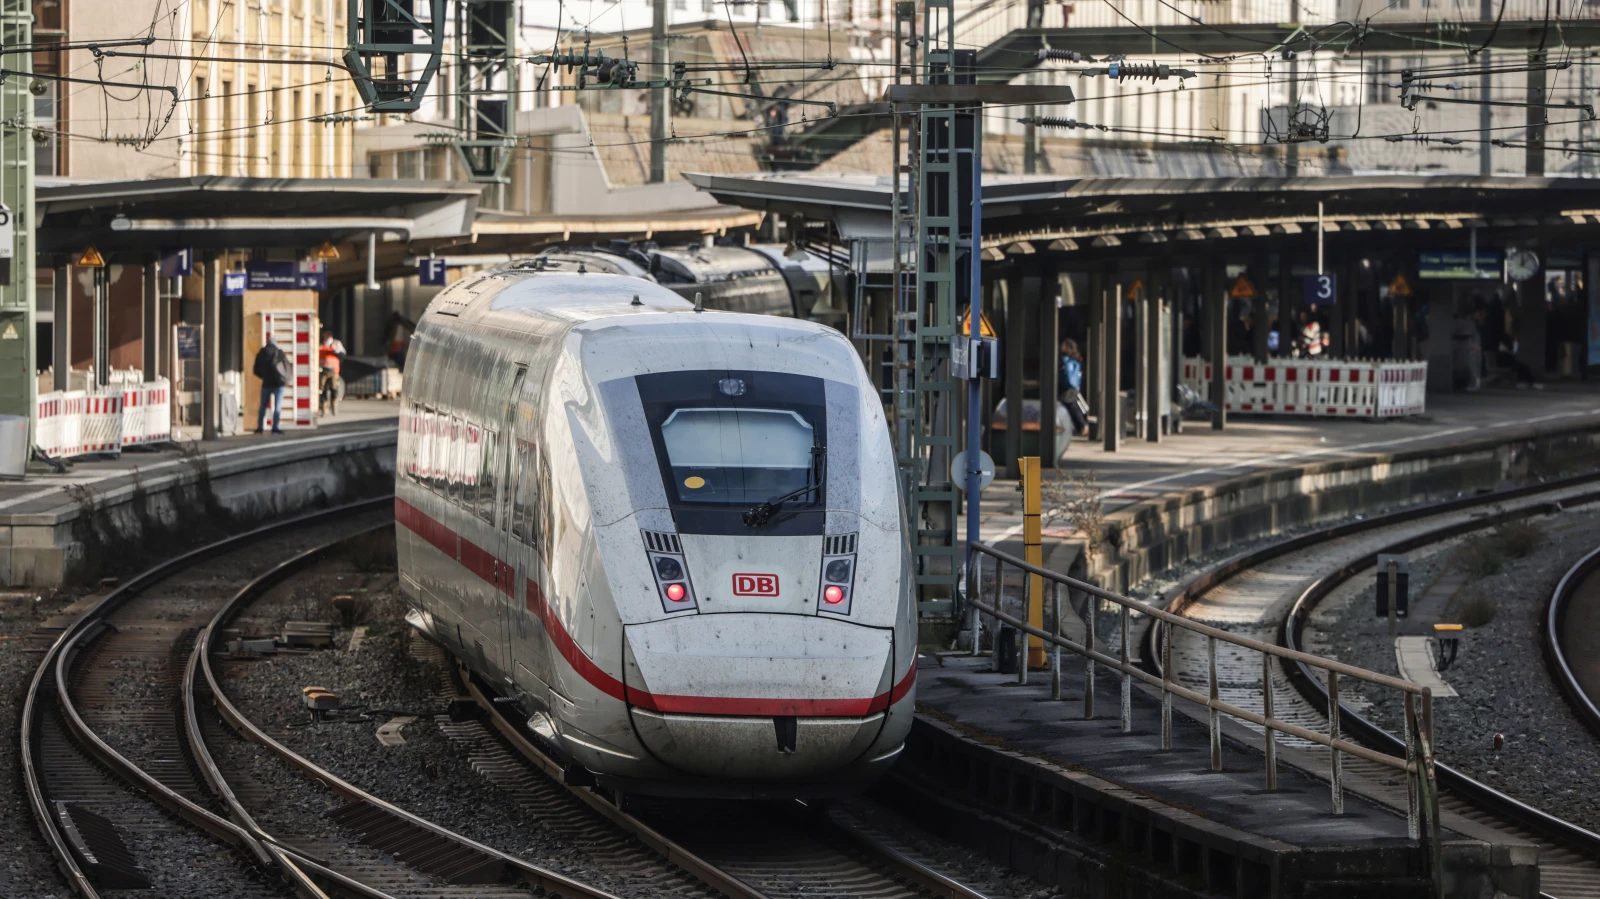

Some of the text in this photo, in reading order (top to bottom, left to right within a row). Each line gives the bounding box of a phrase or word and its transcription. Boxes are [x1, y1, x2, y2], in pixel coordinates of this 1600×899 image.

[178, 250, 188, 270] 1
[430, 260, 442, 280] F
[1317, 276, 1331, 298] 3
[738, 576, 775, 593] DB
